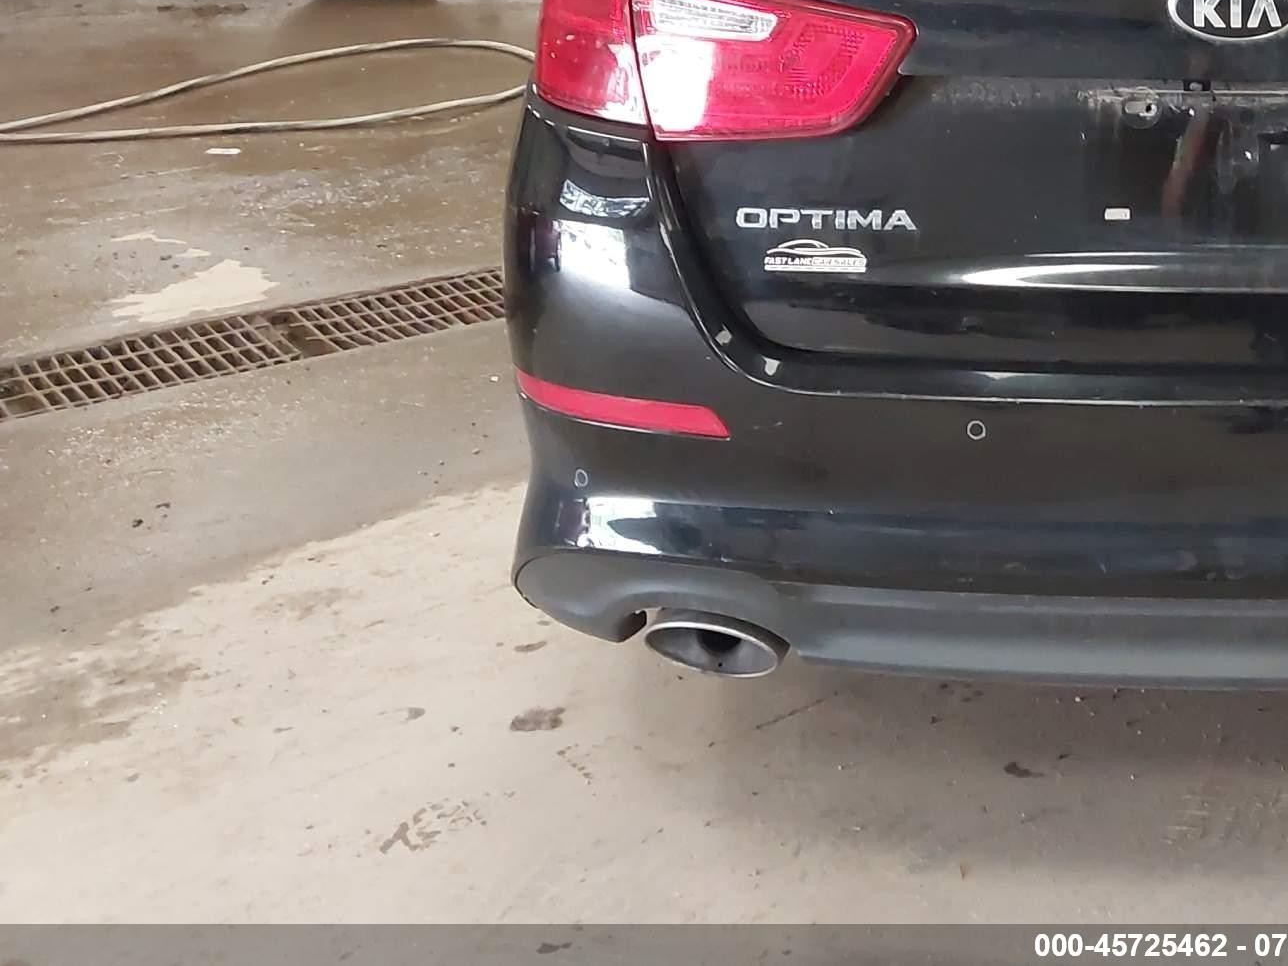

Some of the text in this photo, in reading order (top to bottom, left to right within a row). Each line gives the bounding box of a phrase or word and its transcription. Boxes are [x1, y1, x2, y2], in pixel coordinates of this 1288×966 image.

[735, 207, 918, 231] OPTIMA
[764, 256, 787, 265] FAST
[788, 256, 812, 266] LANE
